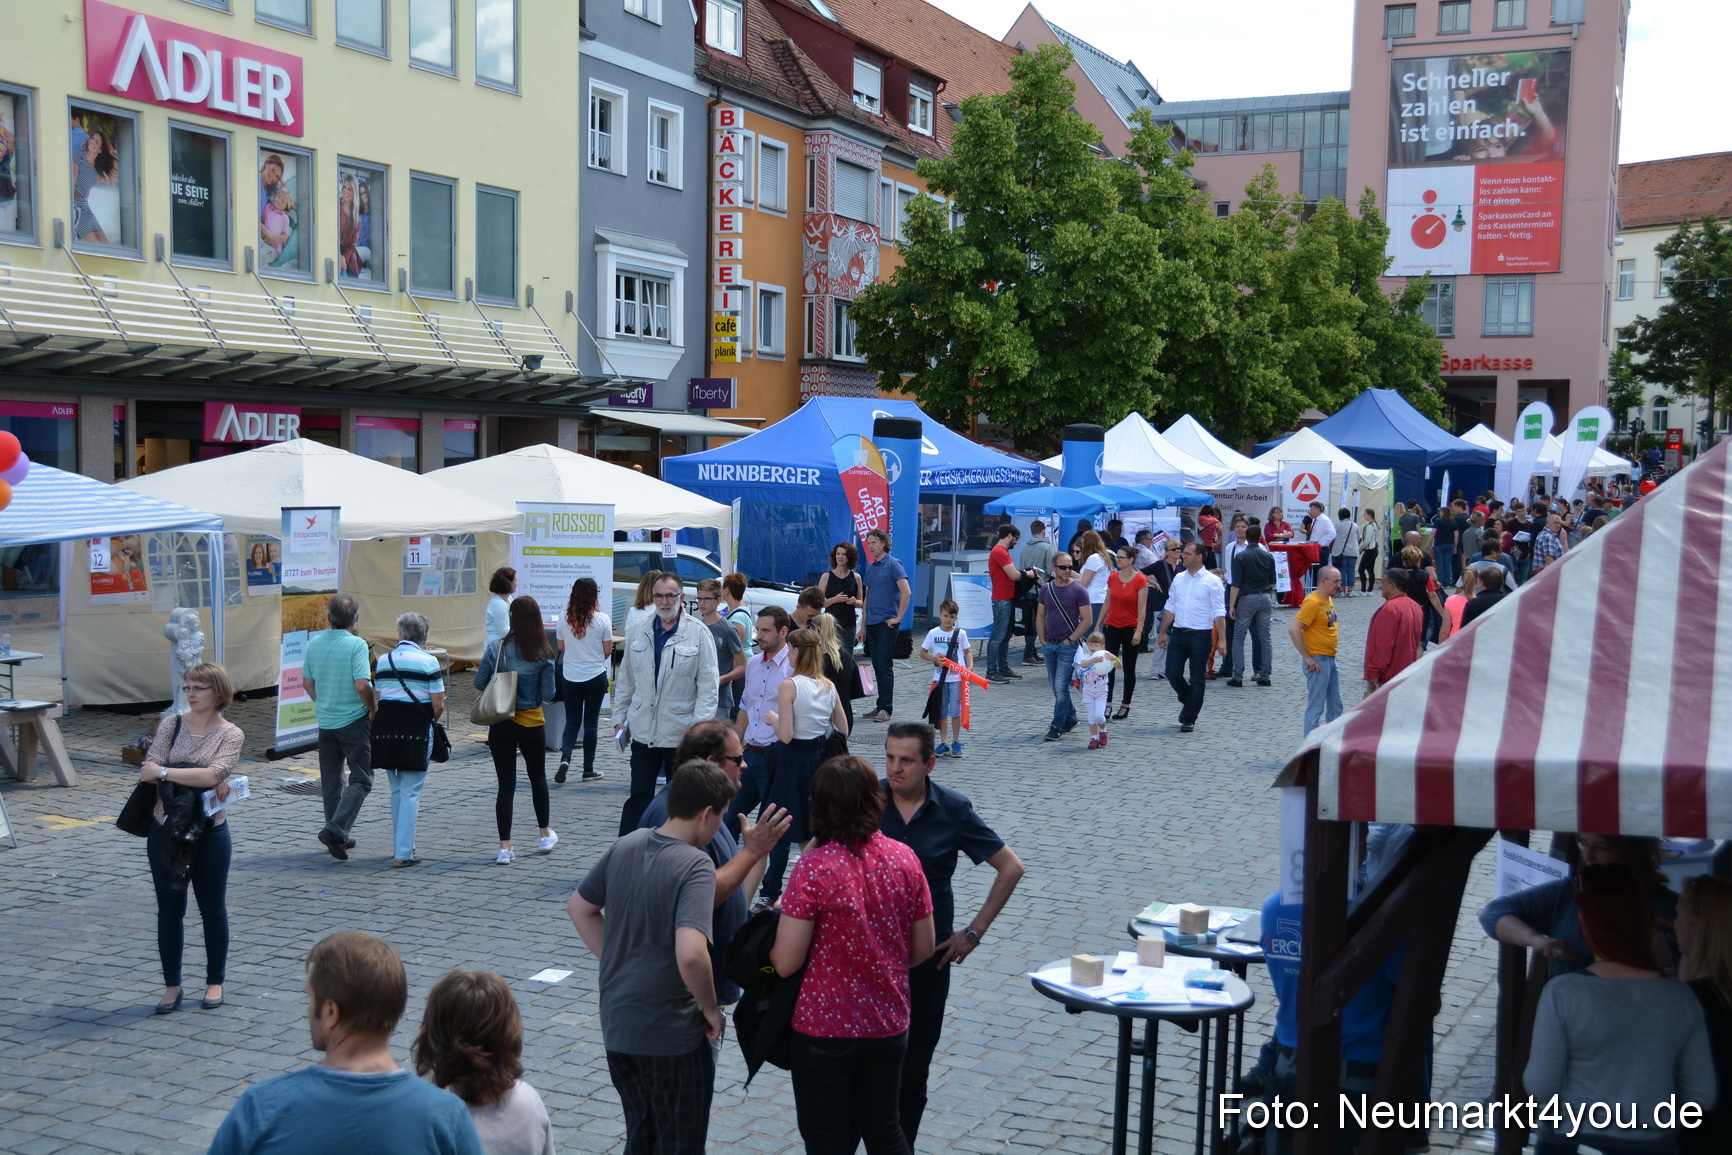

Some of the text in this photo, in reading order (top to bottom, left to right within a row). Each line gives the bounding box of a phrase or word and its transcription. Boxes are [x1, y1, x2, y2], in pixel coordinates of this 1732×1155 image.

[111, 14, 295, 126] ADLER
[1402, 68, 1510, 92] Schneller
[1400, 96, 1476, 117] zahlen
[1400, 118, 1526, 142] ist einfach.
[1522, 175, 1555, 184] kontakt-
[185, 184, 209, 200] SEITE
[1520, 186, 1542, 194] kann:
[719, 110, 735, 309] BÄCKEREI
[1478, 210, 1540, 221] SparkassenCard
[1477, 220, 1554, 230] das Kassenterminal
[1509, 232, 1533, 240] fertig.
[715, 319, 737, 333] café
[714, 346, 737, 359] plank
[1439, 354, 1534, 373] Sparkasse
[692, 385, 730, 402] liberty
[52, 402, 74, 414] ADLER
[213, 403, 300, 442] ADLER
[698, 463, 820, 485] NÜRNBERGER
[935, 468, 1035, 485] VERSICHERUNGSGRUPPE
[1235, 492, 1245, 500] für
[1246, 493, 1268, 501] Arbeit
[552, 513, 605, 532] ROSSBO
[664, 544, 672, 554] 10
[94, 553, 104, 566] 12
[410, 551, 420, 563] 11
[284, 568, 299, 577] JETZT
[313, 567, 337, 576] Traumjob
